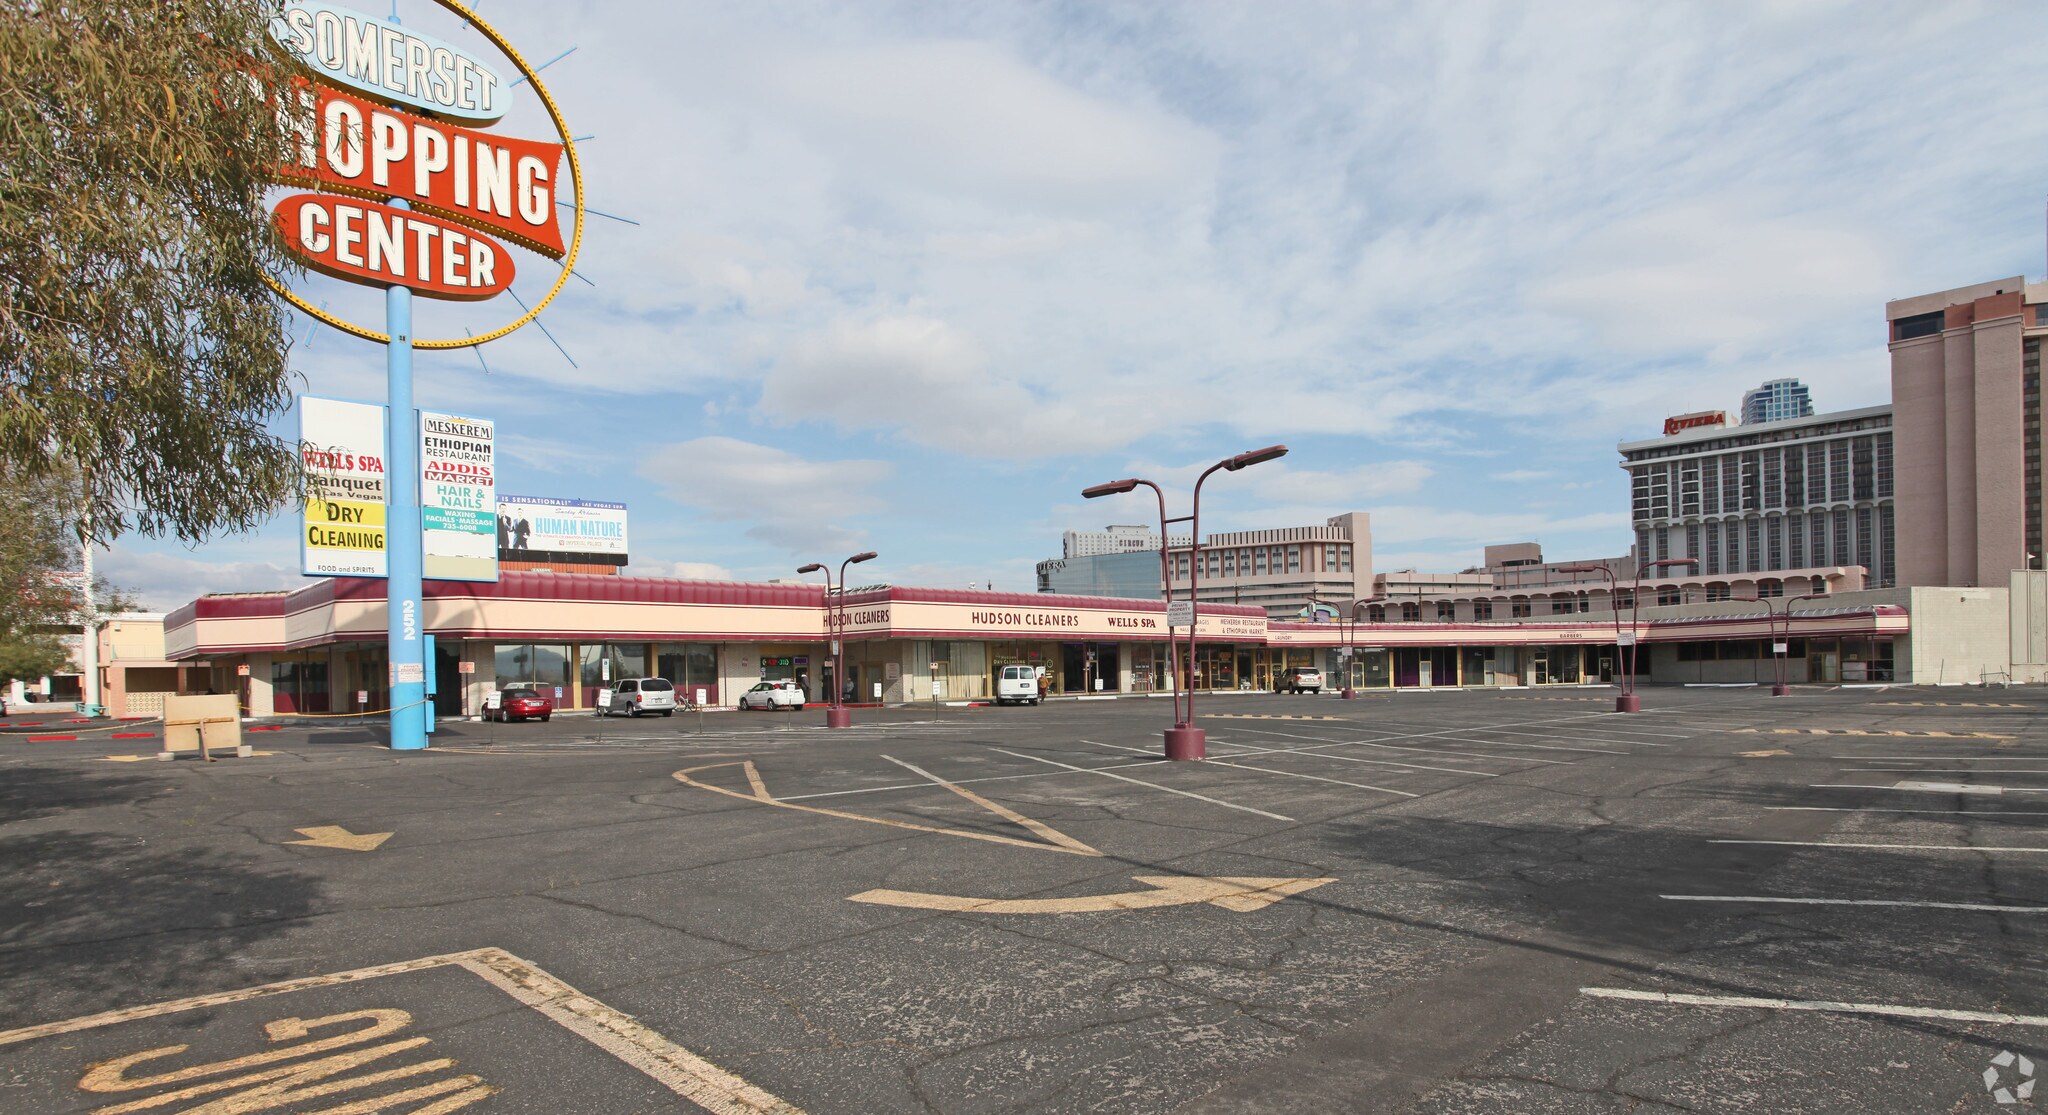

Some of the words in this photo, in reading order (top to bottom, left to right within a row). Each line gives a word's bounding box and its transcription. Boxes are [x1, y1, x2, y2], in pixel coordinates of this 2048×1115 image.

[287, 8, 497, 111] SOMERSET
[222, 70, 548, 226] HOPPING
[300, 202, 497, 288] CENTER
[427, 420, 490, 438] MESKEREM
[1663, 413, 1724, 435] RIVIERA
[425, 437, 491, 454] ETHIOPIAN
[302, 451, 354, 471] WELLS
[359, 455, 385, 473] SPA
[426, 448, 491, 463] RESTAURANT
[427, 461, 491, 476] ADDIS
[427, 472, 492, 486] MARKET
[347, 492, 383, 500] Vegas
[437, 485, 471, 497] HAIR
[476, 488, 485, 499] &
[441, 496, 482, 509] NAILS
[328, 502, 364, 522] DRY
[444, 510, 476, 518] WAXING
[425, 515, 455, 523] FACIALS
[459, 518, 493, 526] MASSAGE
[535, 517, 577, 535] HUMAN
[580, 519, 623, 537] NATURE
[309, 526, 384, 549] CLEANING
[1119, 539, 1144, 547] CIRCUS
[402, 600, 416, 641] 252
[854, 609, 890, 625] CLEANERS
[972, 611, 1021, 625] HUDSON
[1025, 613, 1079, 627] CLEANERS
[1107, 617, 1138, 628] WELLS
[1141, 618, 1156, 628] SPA
